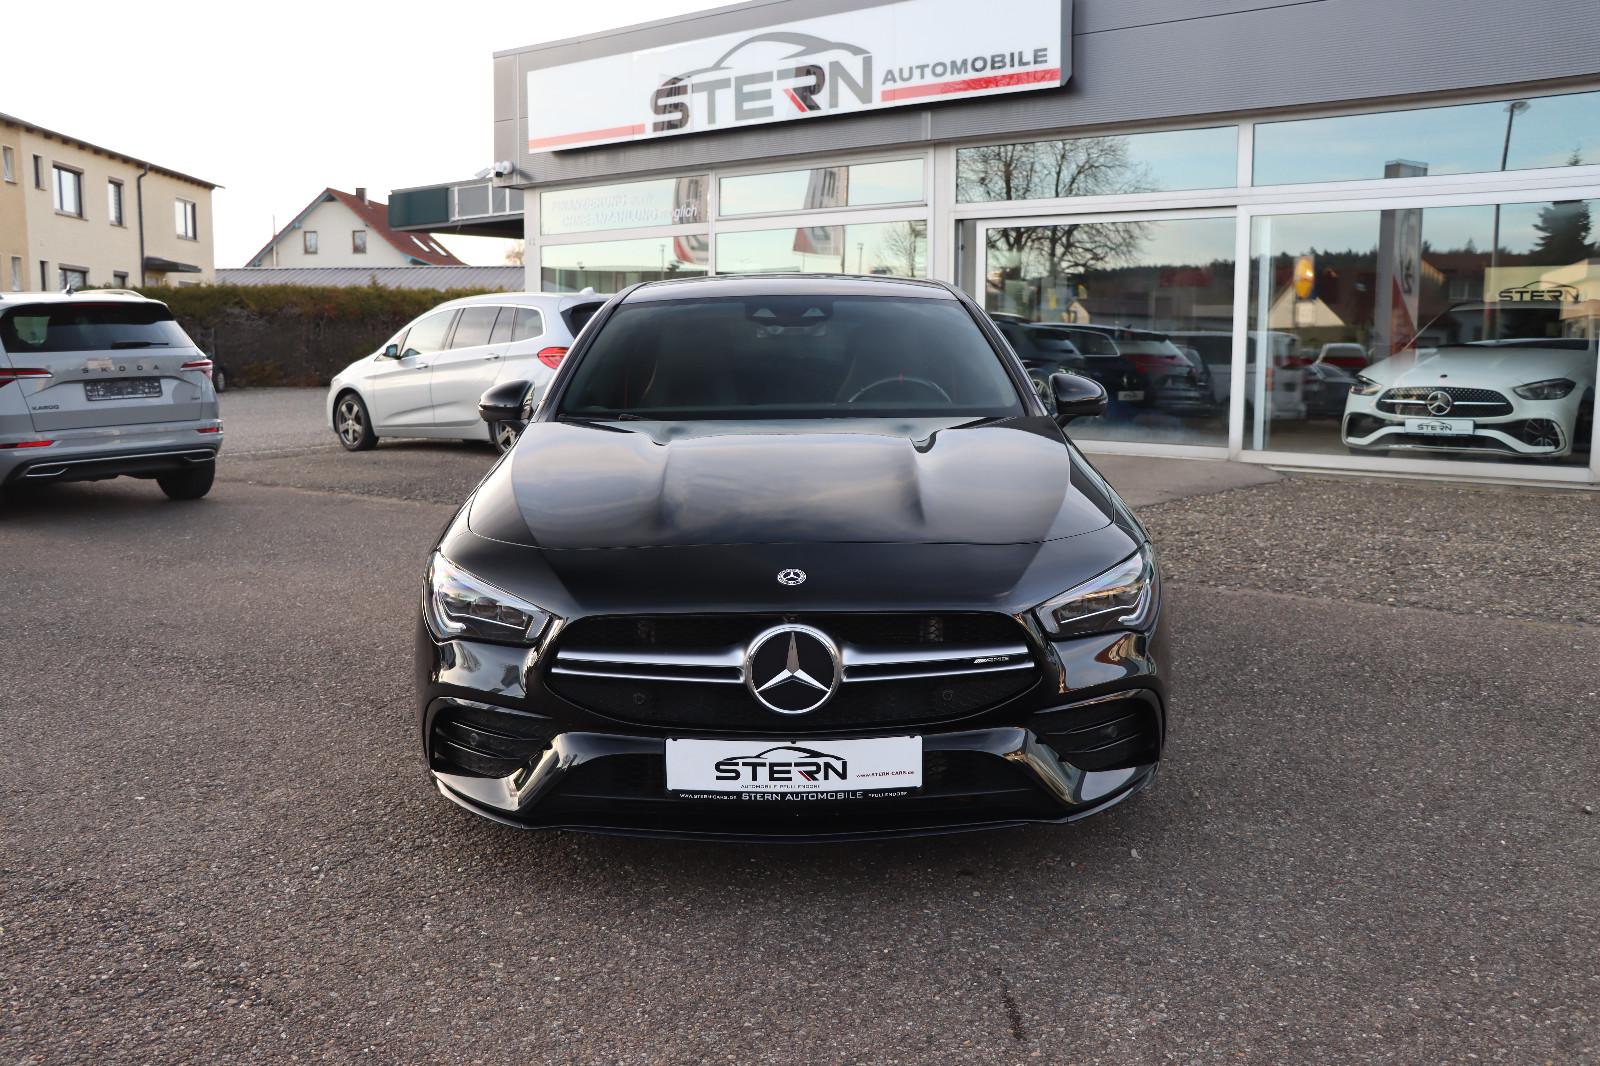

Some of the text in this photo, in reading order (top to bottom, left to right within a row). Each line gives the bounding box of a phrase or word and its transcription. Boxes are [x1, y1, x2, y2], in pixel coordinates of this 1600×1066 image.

[650, 47, 1049, 133] STERN AUTOMOBILE
[1498, 288, 1580, 303] STERN
[1417, 423, 1453, 432] STERN
[714, 760, 848, 781] STERN
[741, 792, 781, 801] STERN
[785, 791, 864, 801] AUTOMOBILE
